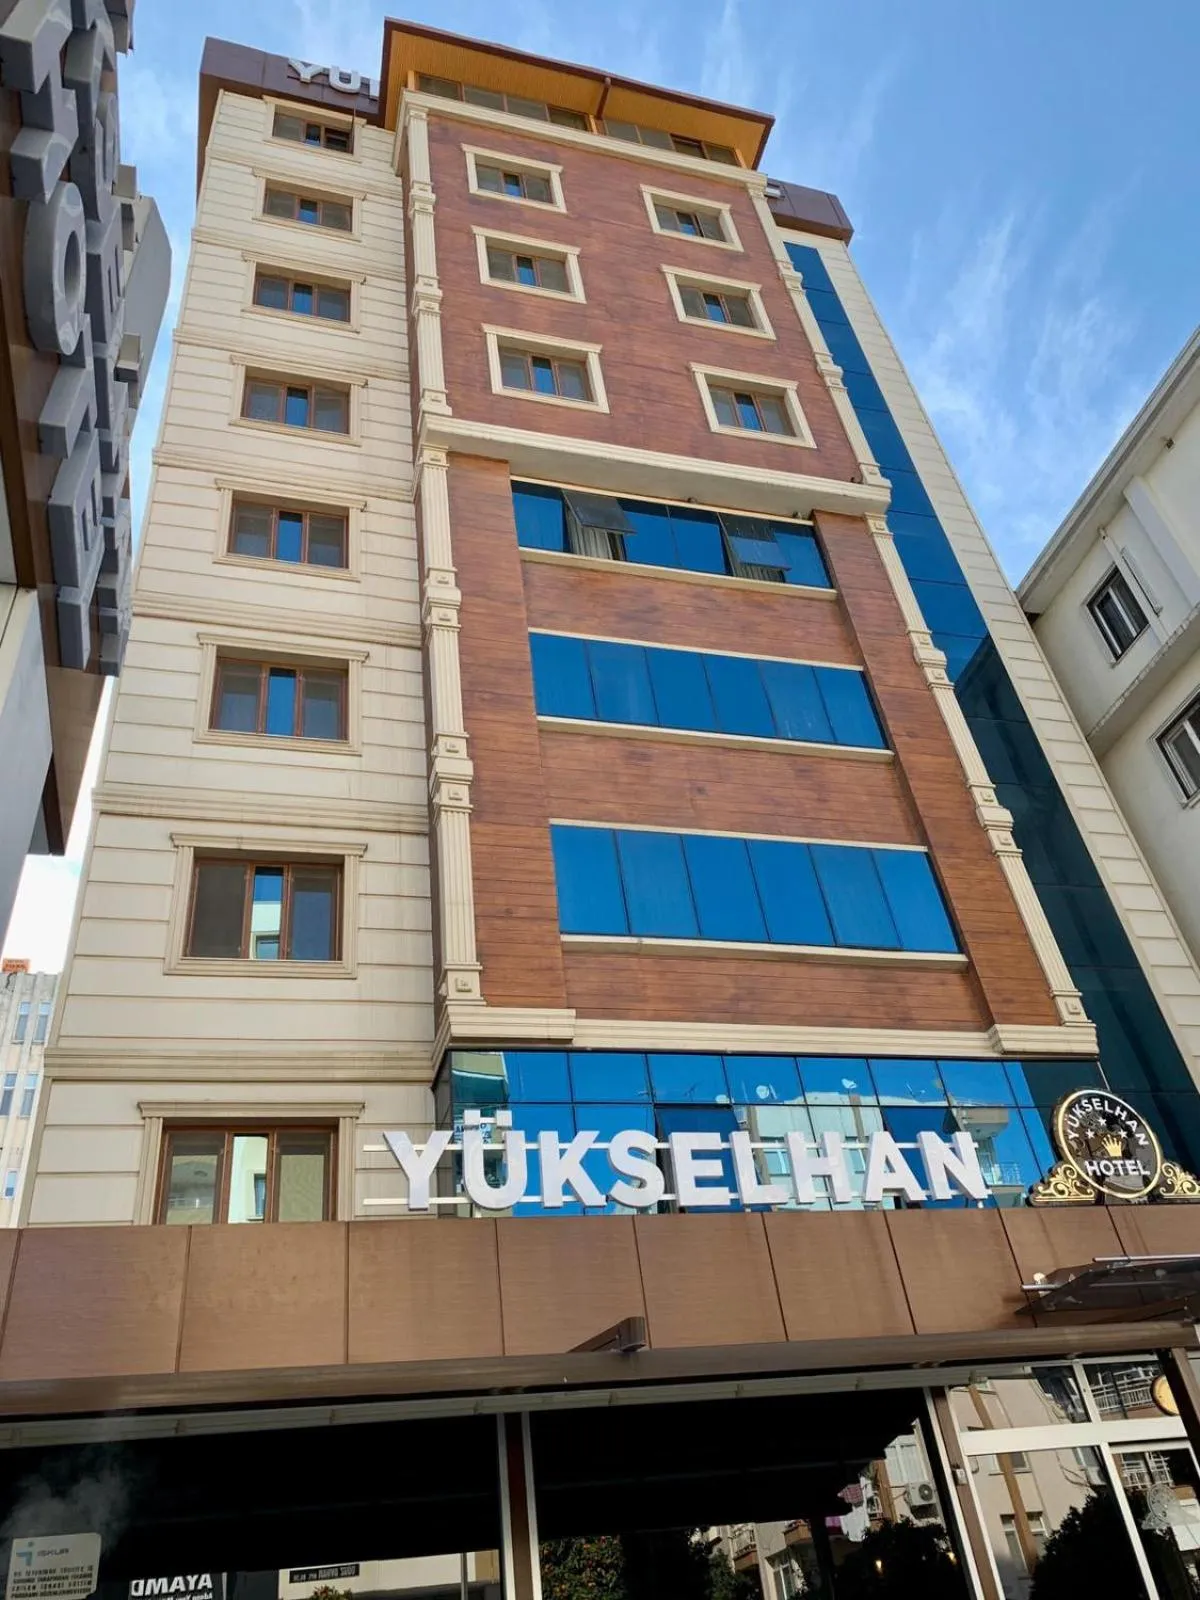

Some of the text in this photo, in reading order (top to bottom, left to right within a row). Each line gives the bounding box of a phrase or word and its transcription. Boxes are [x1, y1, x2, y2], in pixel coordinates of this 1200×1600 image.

[1066, 1097, 1149, 1146] YÜKSELHAN
[383, 1109, 990, 1211] YÜKSELHAN
[1084, 1159, 1150, 1177] HOTEL
